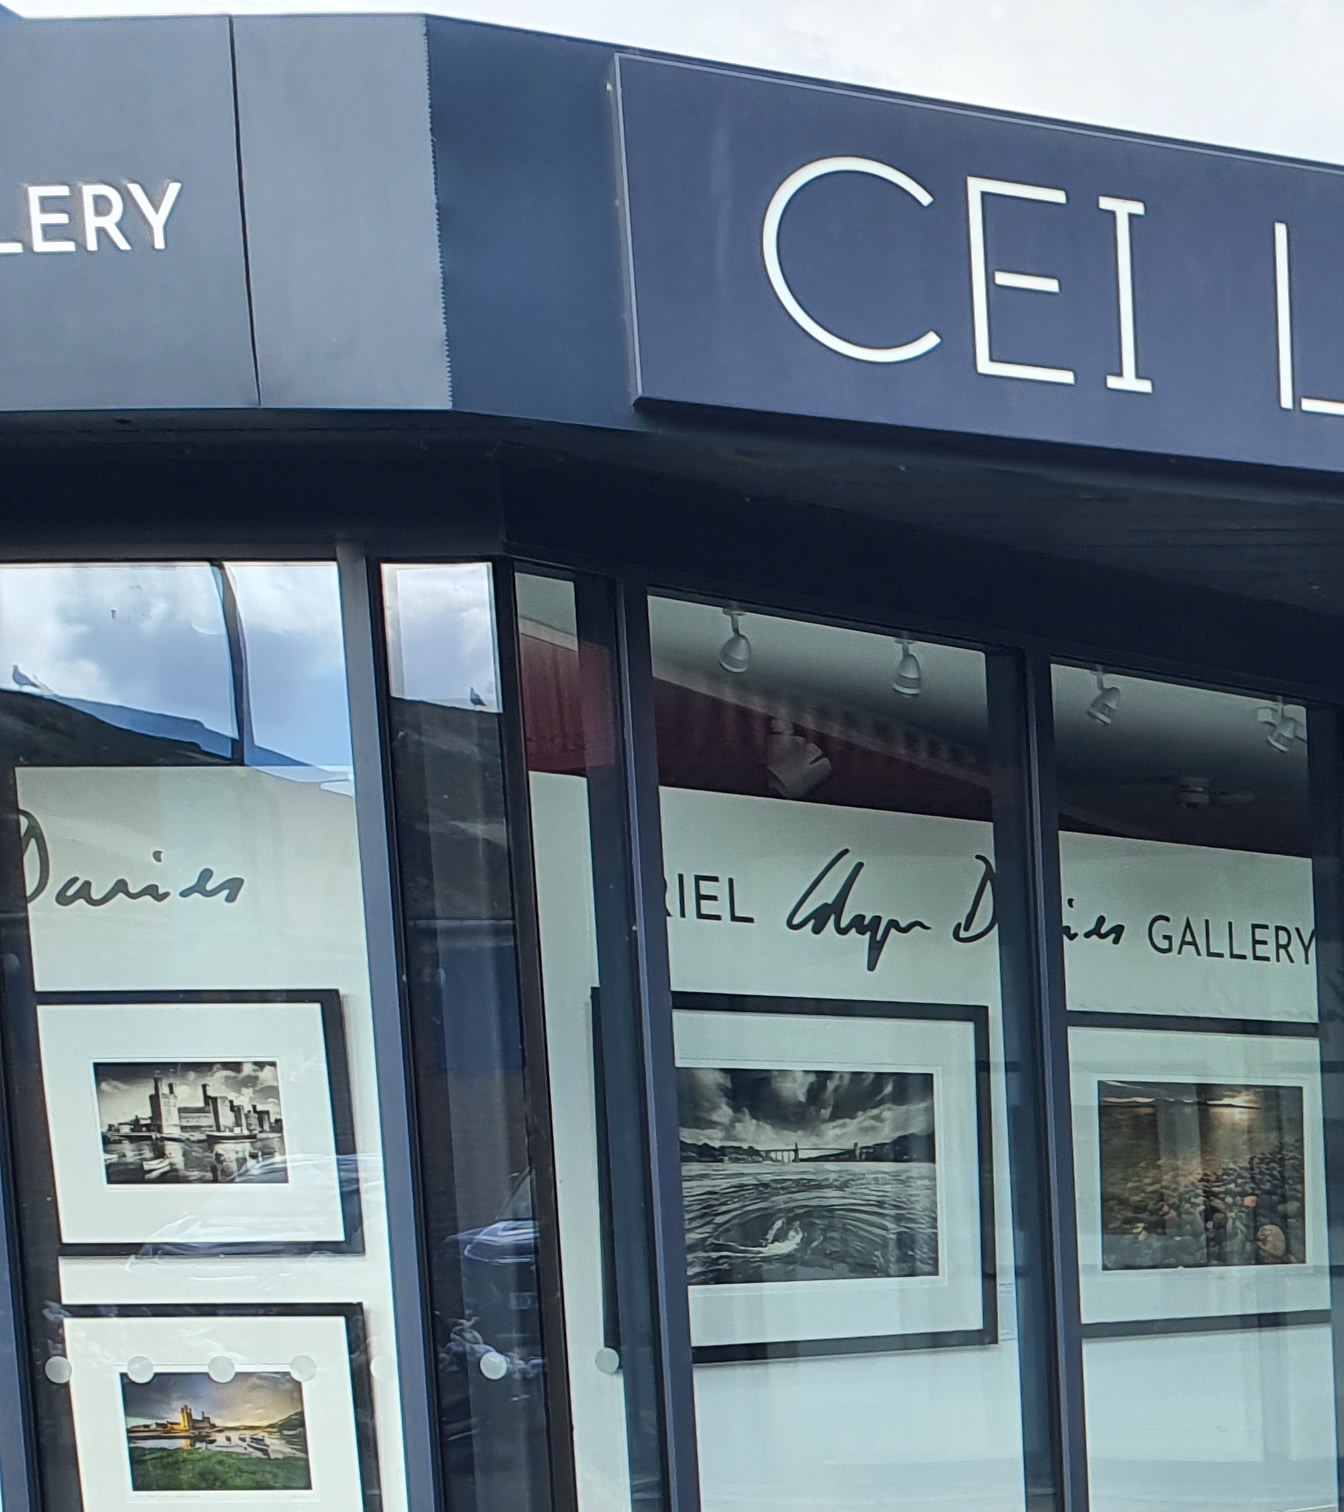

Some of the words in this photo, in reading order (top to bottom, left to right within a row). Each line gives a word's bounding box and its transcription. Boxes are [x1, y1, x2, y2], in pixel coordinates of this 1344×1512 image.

[761, 155, 1153, 395] CEI
[664, 872, 756, 924] IEL
[1147, 914, 1316, 966] GALLERY
